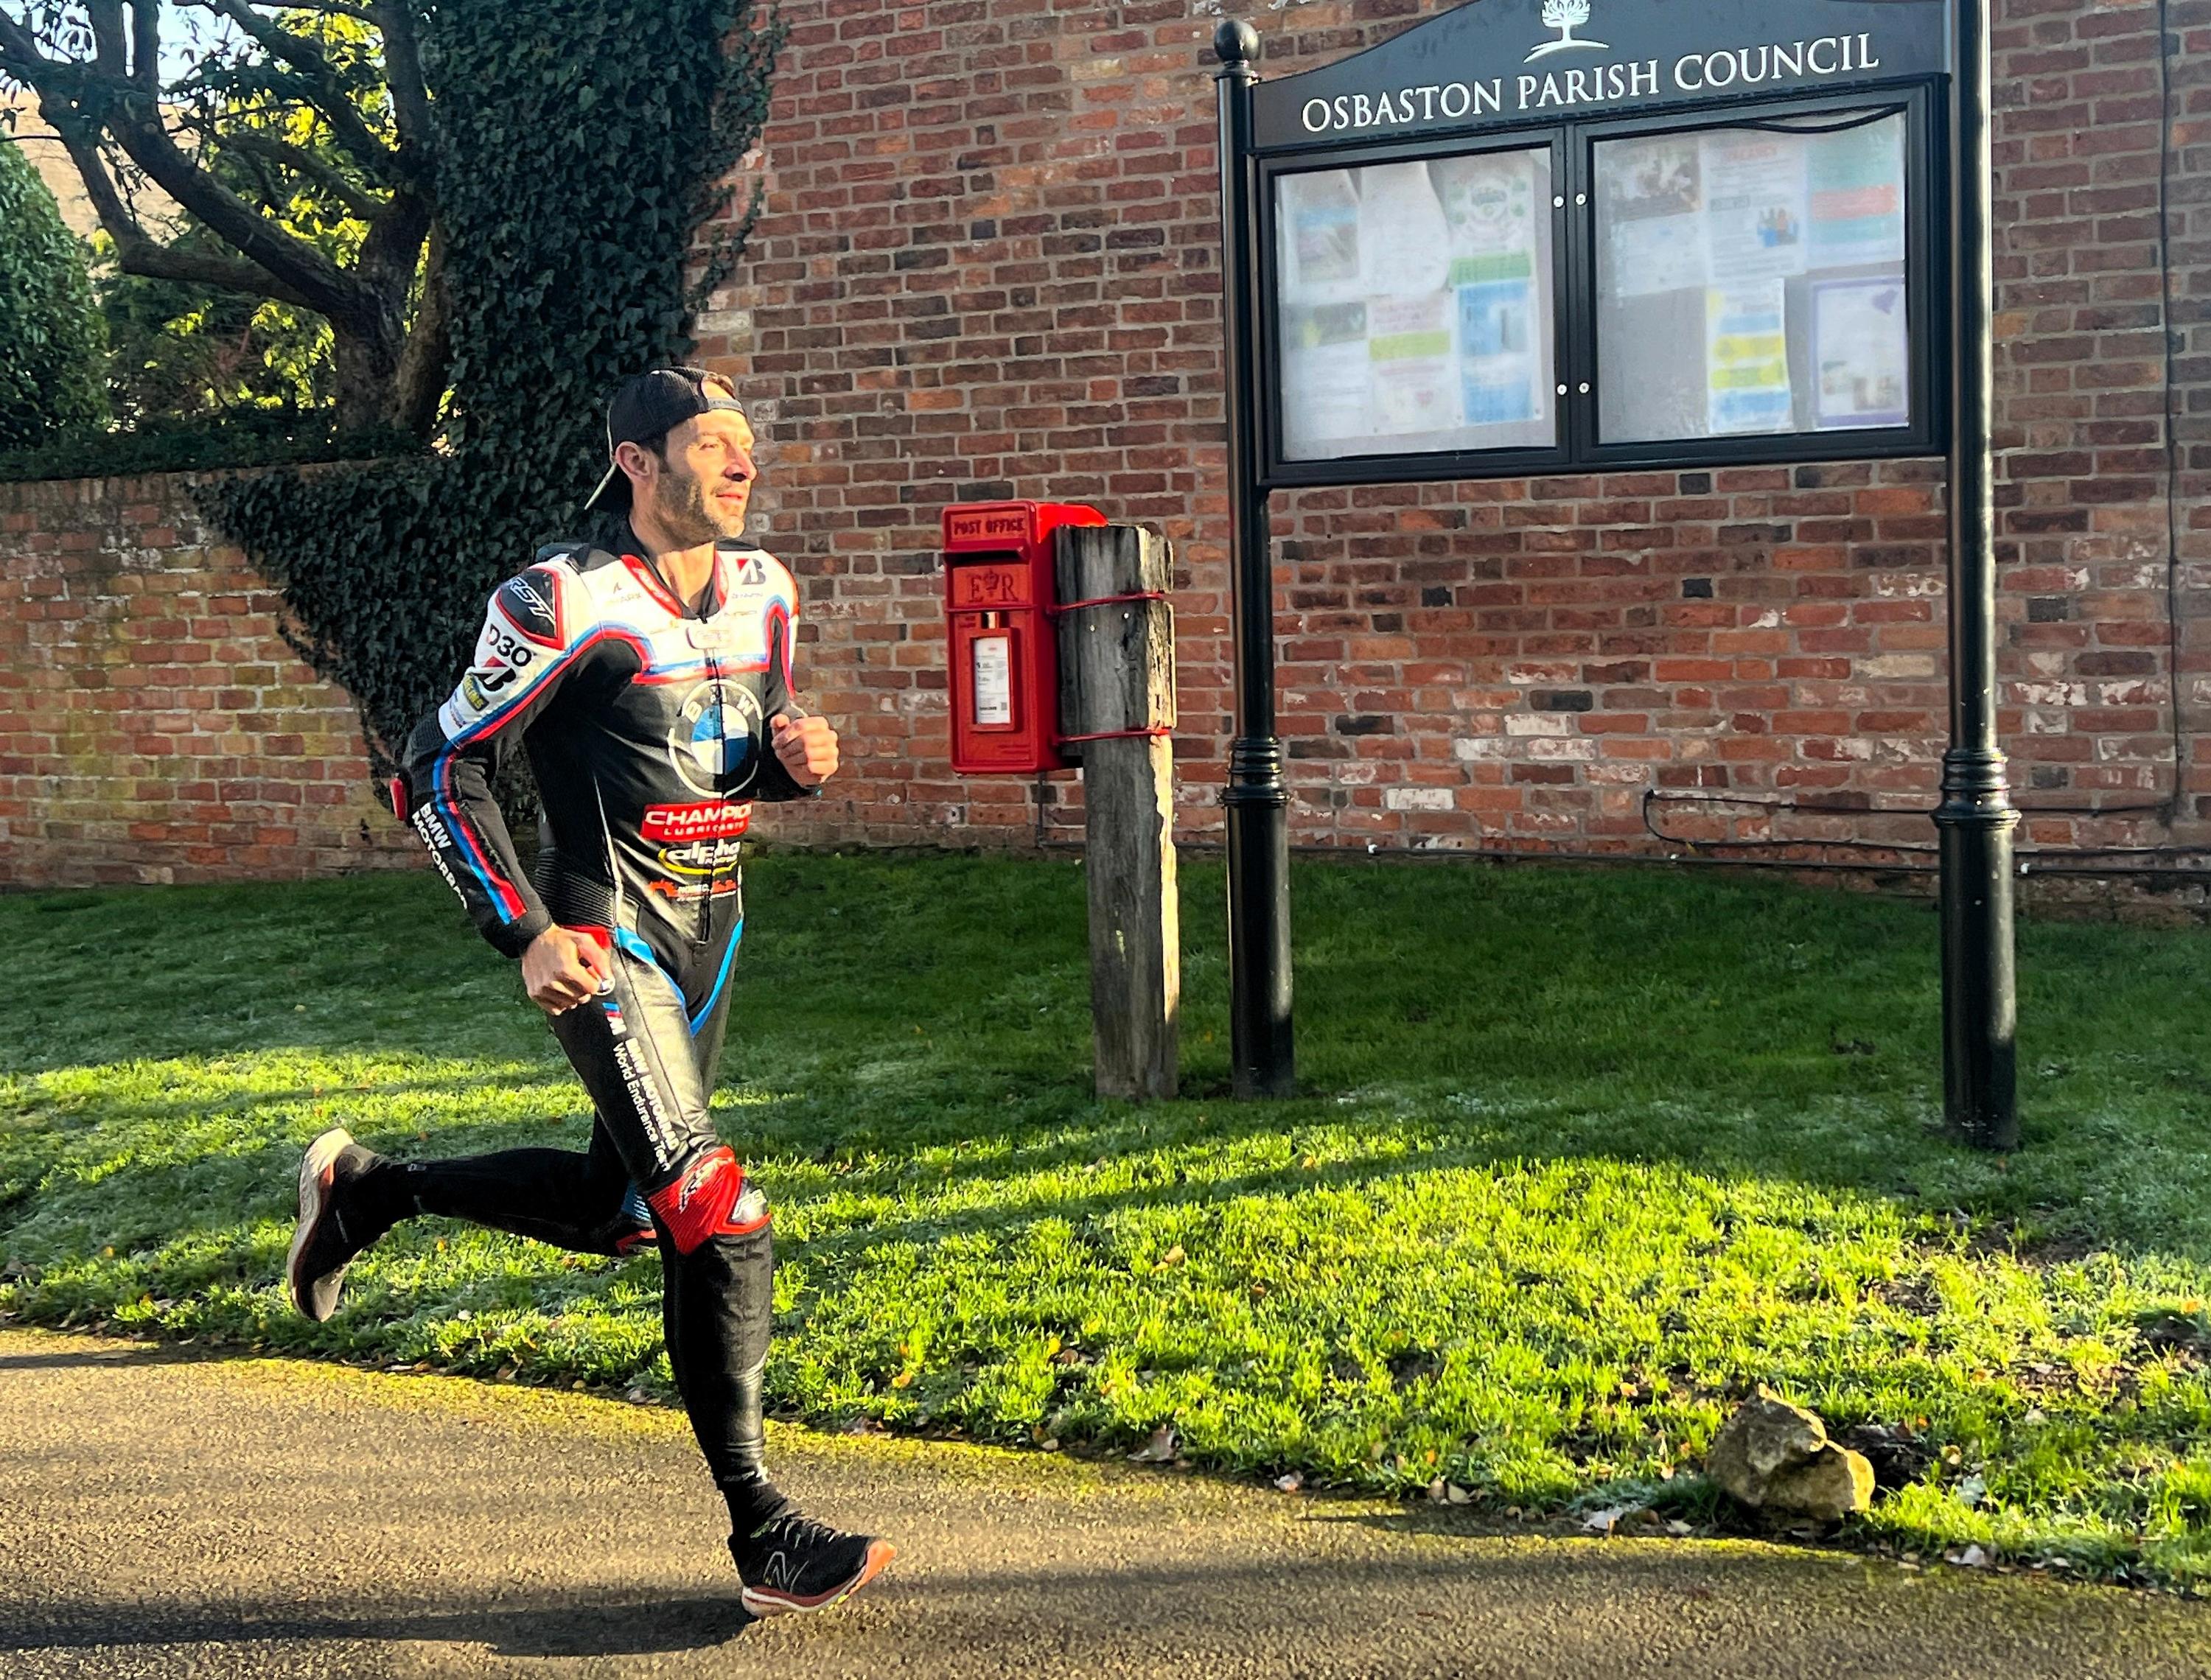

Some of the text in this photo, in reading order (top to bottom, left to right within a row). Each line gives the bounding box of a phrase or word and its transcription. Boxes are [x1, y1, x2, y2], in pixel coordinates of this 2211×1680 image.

[1301, 32, 1881, 133] OSBASTON PARISH COUNCIL
[954, 517, 1024, 535] POST OFFICE
[420, 802, 452, 849] BMW
[612, 1041, 671, 1172] World Endurance Team
[625, 1037, 680, 1152] BMW MOTORRAD
